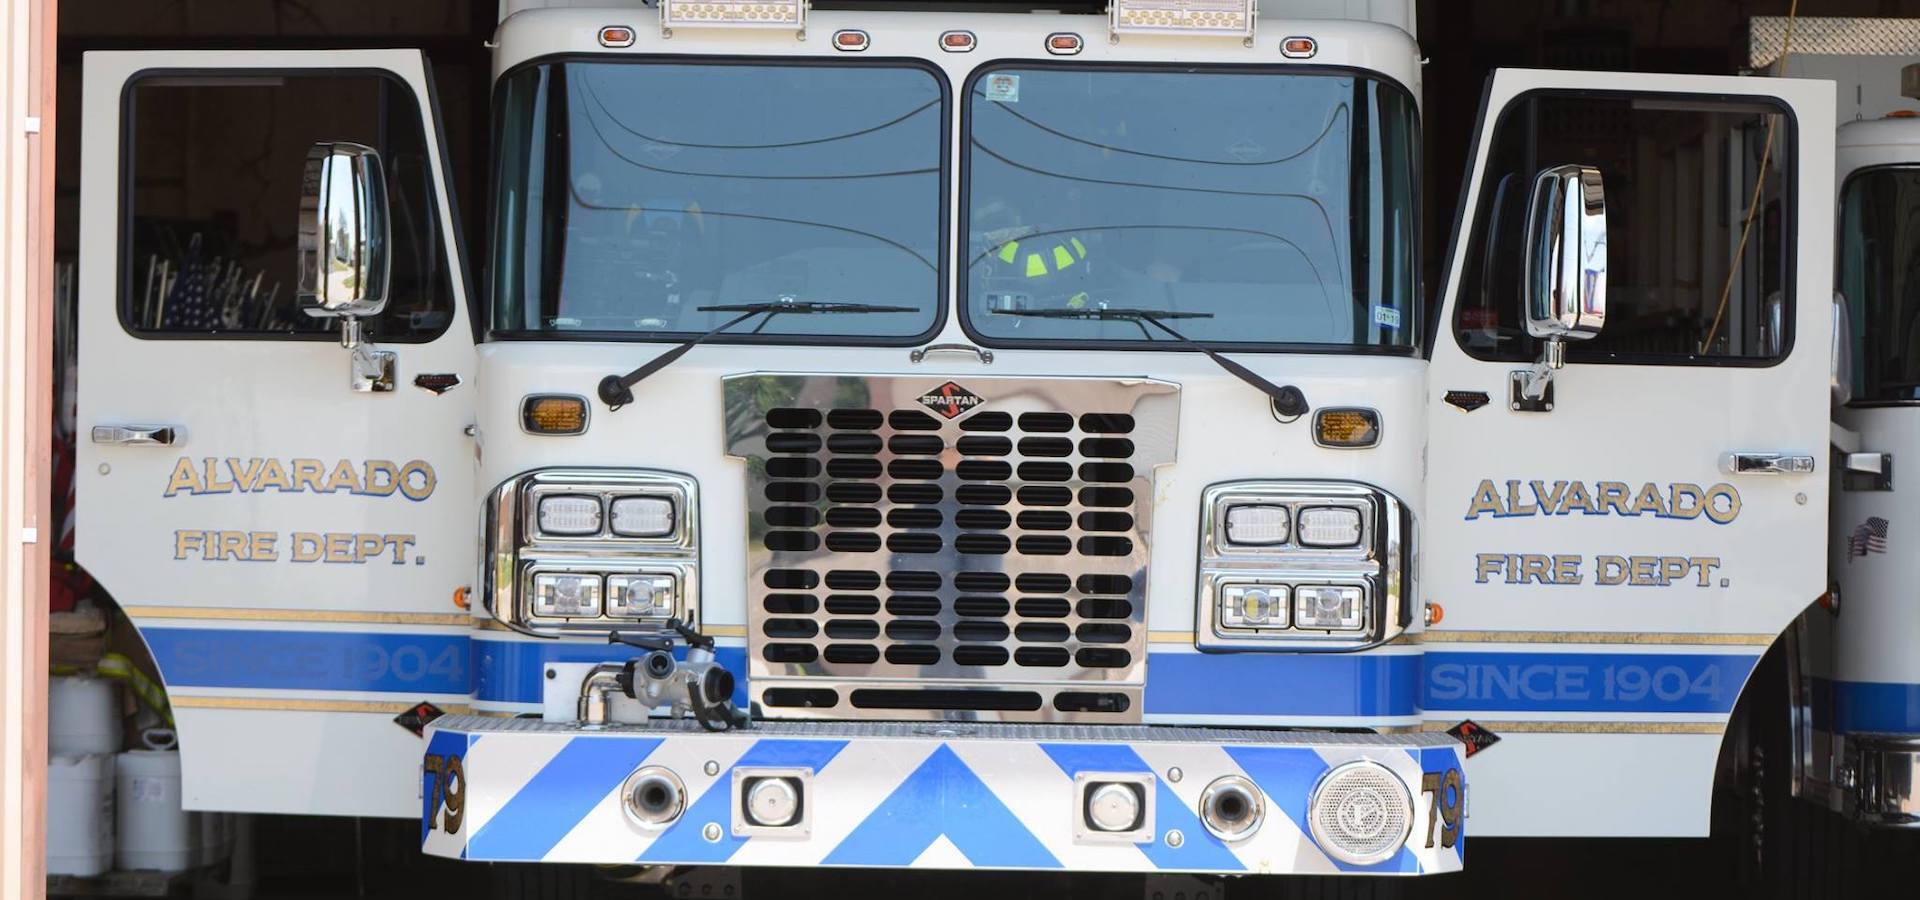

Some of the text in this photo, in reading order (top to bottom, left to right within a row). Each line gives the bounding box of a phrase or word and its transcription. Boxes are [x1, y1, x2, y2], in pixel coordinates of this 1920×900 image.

[922, 395, 978, 405] SPARTAN
[163, 456, 438, 502] ALVARADO
[1465, 479, 1742, 525] ALVARADO
[174, 529, 425, 565] FIRE DEPT.
[1475, 553, 1730, 588] FIRE DEPT.
[172, 637, 463, 682] SINCE 1904
[1430, 663, 1725, 702] SINCE 1904
[423, 753, 466, 835] 79
[1421, 767, 1465, 850] 79
